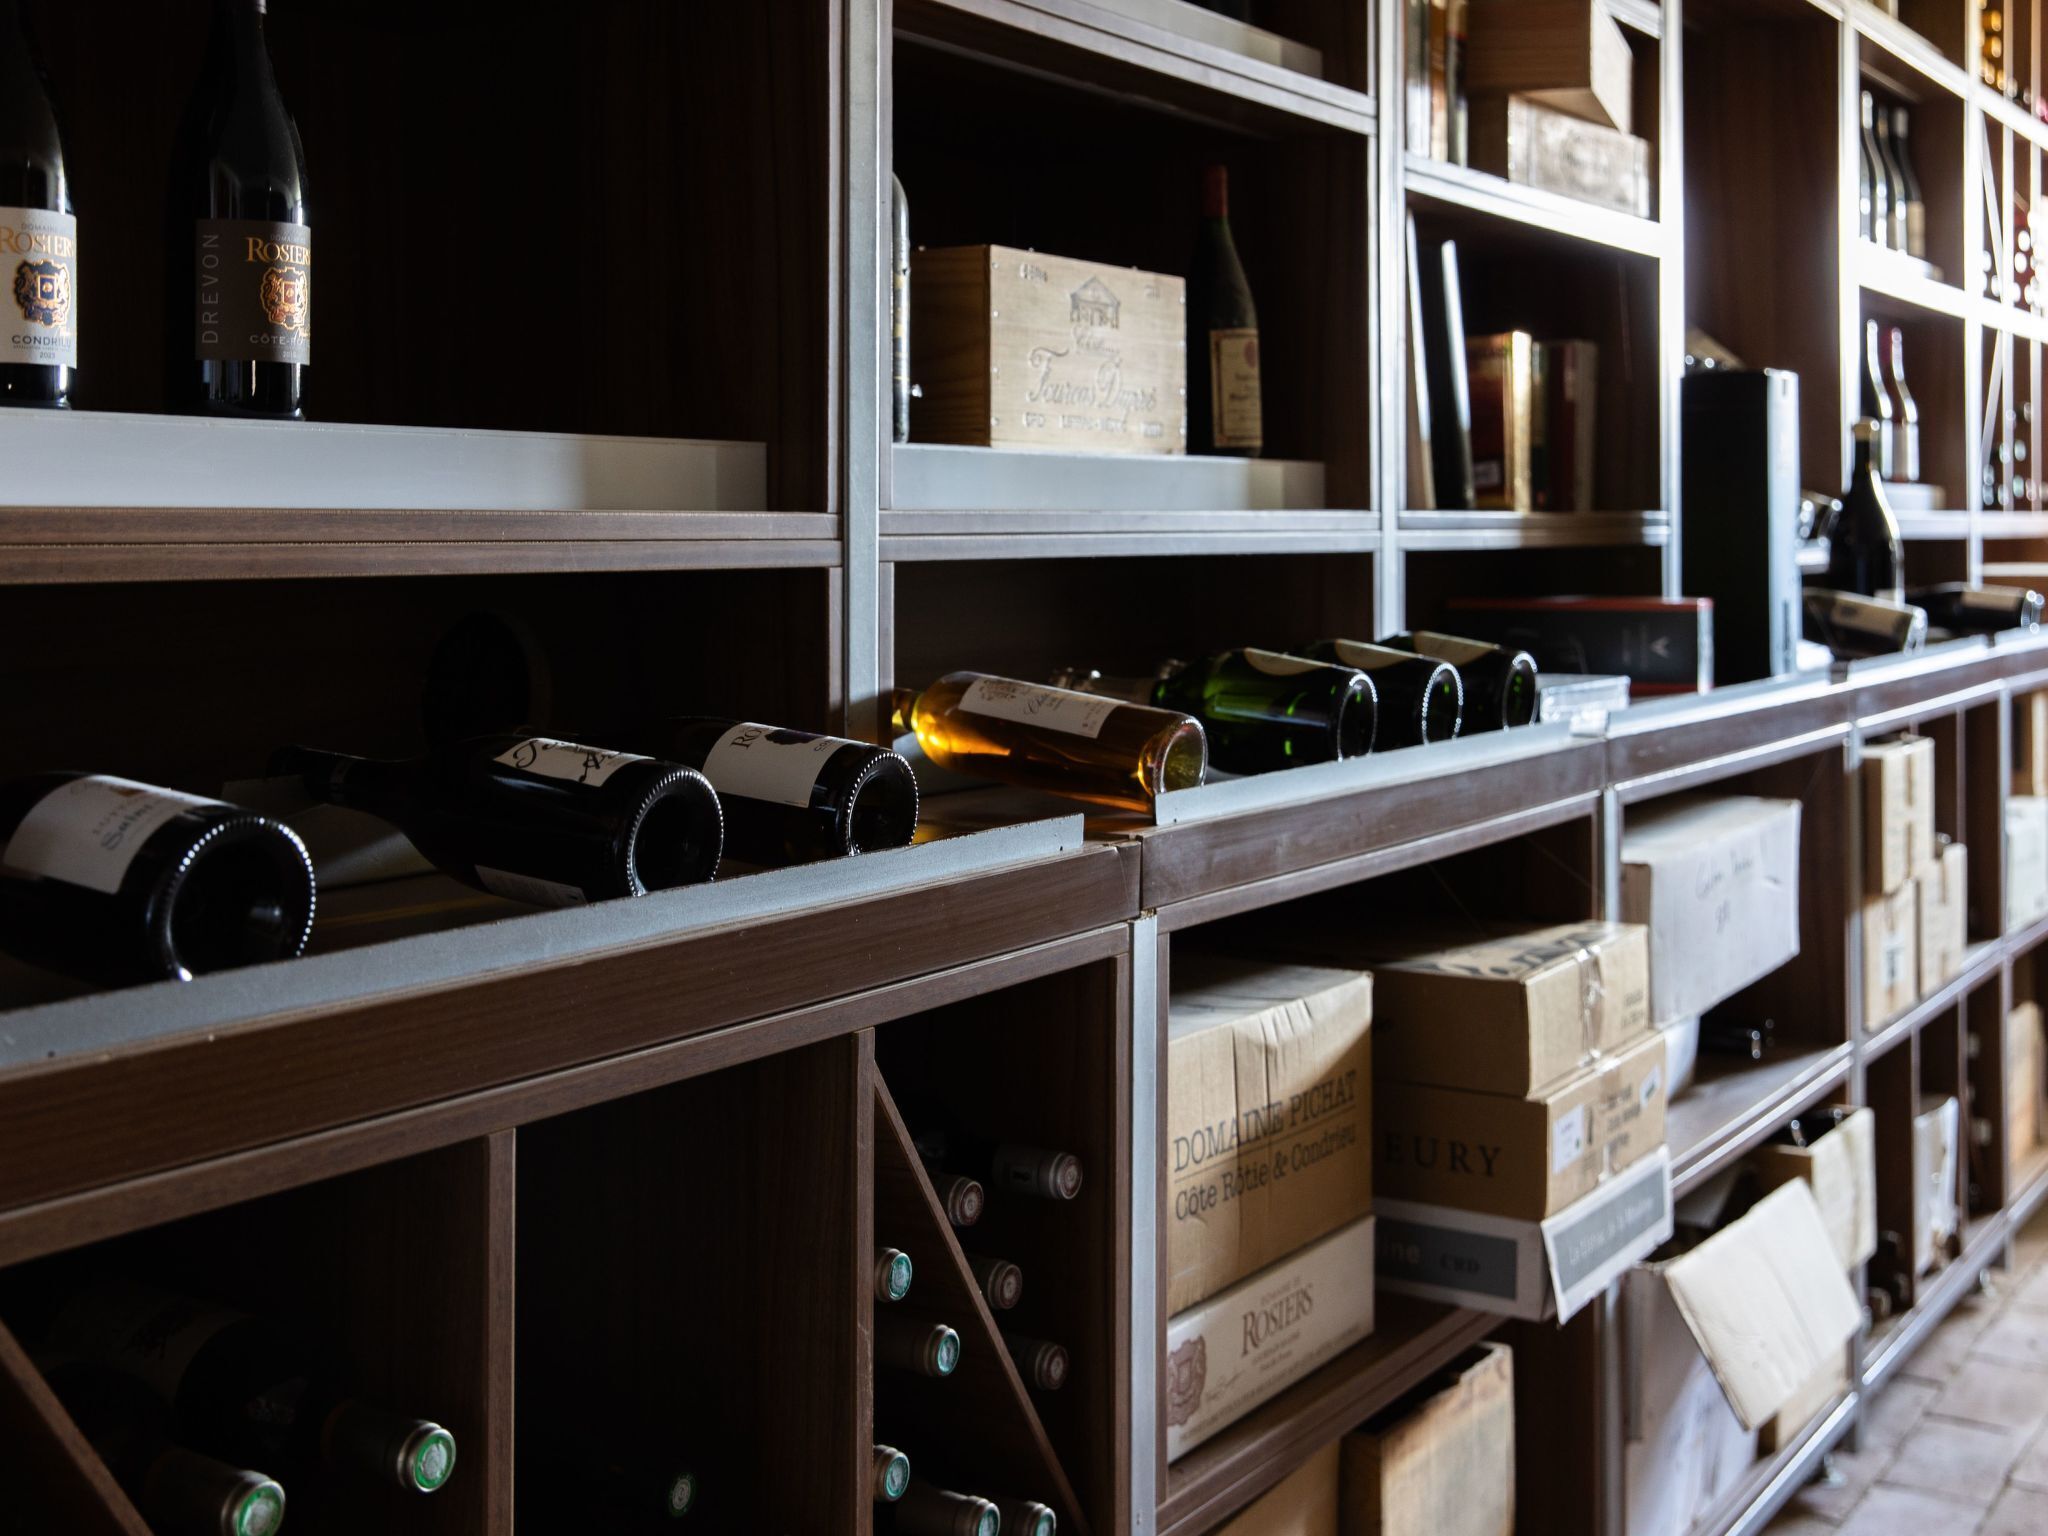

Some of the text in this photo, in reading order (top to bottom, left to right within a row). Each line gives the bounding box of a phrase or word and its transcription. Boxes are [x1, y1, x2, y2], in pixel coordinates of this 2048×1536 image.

[202, 234, 219, 344] DREVON
[12, 335, 71, 347] CONDRI
[1174, 1069, 1357, 1173] DOMAINE PICHAT
[1175, 1183, 1218, 1221] Côte
[1221, 1161, 1269, 1203] Rôtie
[1272, 1150, 1288, 1180] &
[1241, 1286, 1315, 1357] ROSIERS
